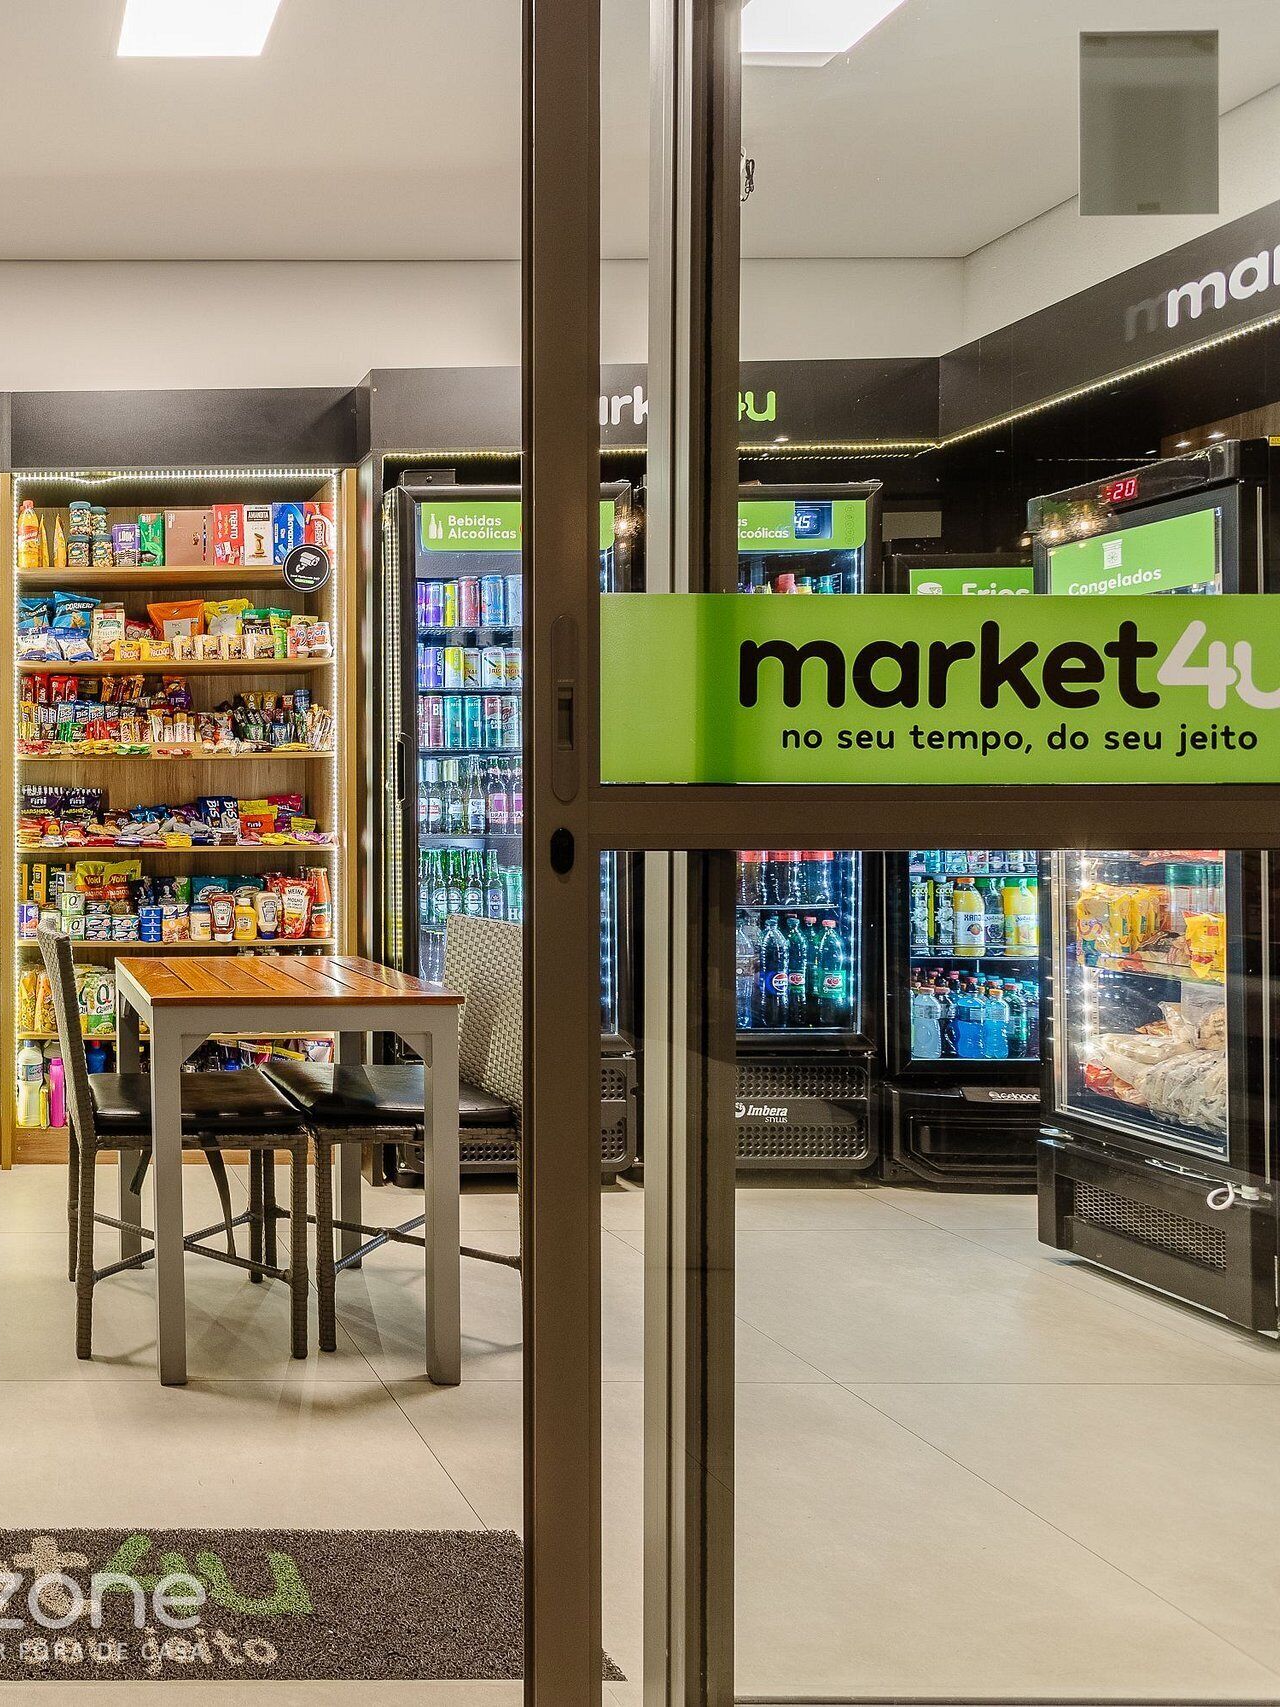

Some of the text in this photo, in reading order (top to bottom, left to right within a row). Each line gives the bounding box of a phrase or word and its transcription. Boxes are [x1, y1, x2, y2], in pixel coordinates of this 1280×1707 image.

[230, 509, 238, 539] TRENTO
[448, 515, 501, 527] Bebidas
[448, 527, 517, 540] Alcoólicas
[1069, 567, 1161, 595] Congelados
[738, 619, 1280, 710] market4u
[781, 723, 1258, 757] no seu tempo, do seu jeito
[86, 876, 102, 884] Yoki
[111, 875, 128, 884] Yoki
[746, 1105, 788, 1116] Imbera
